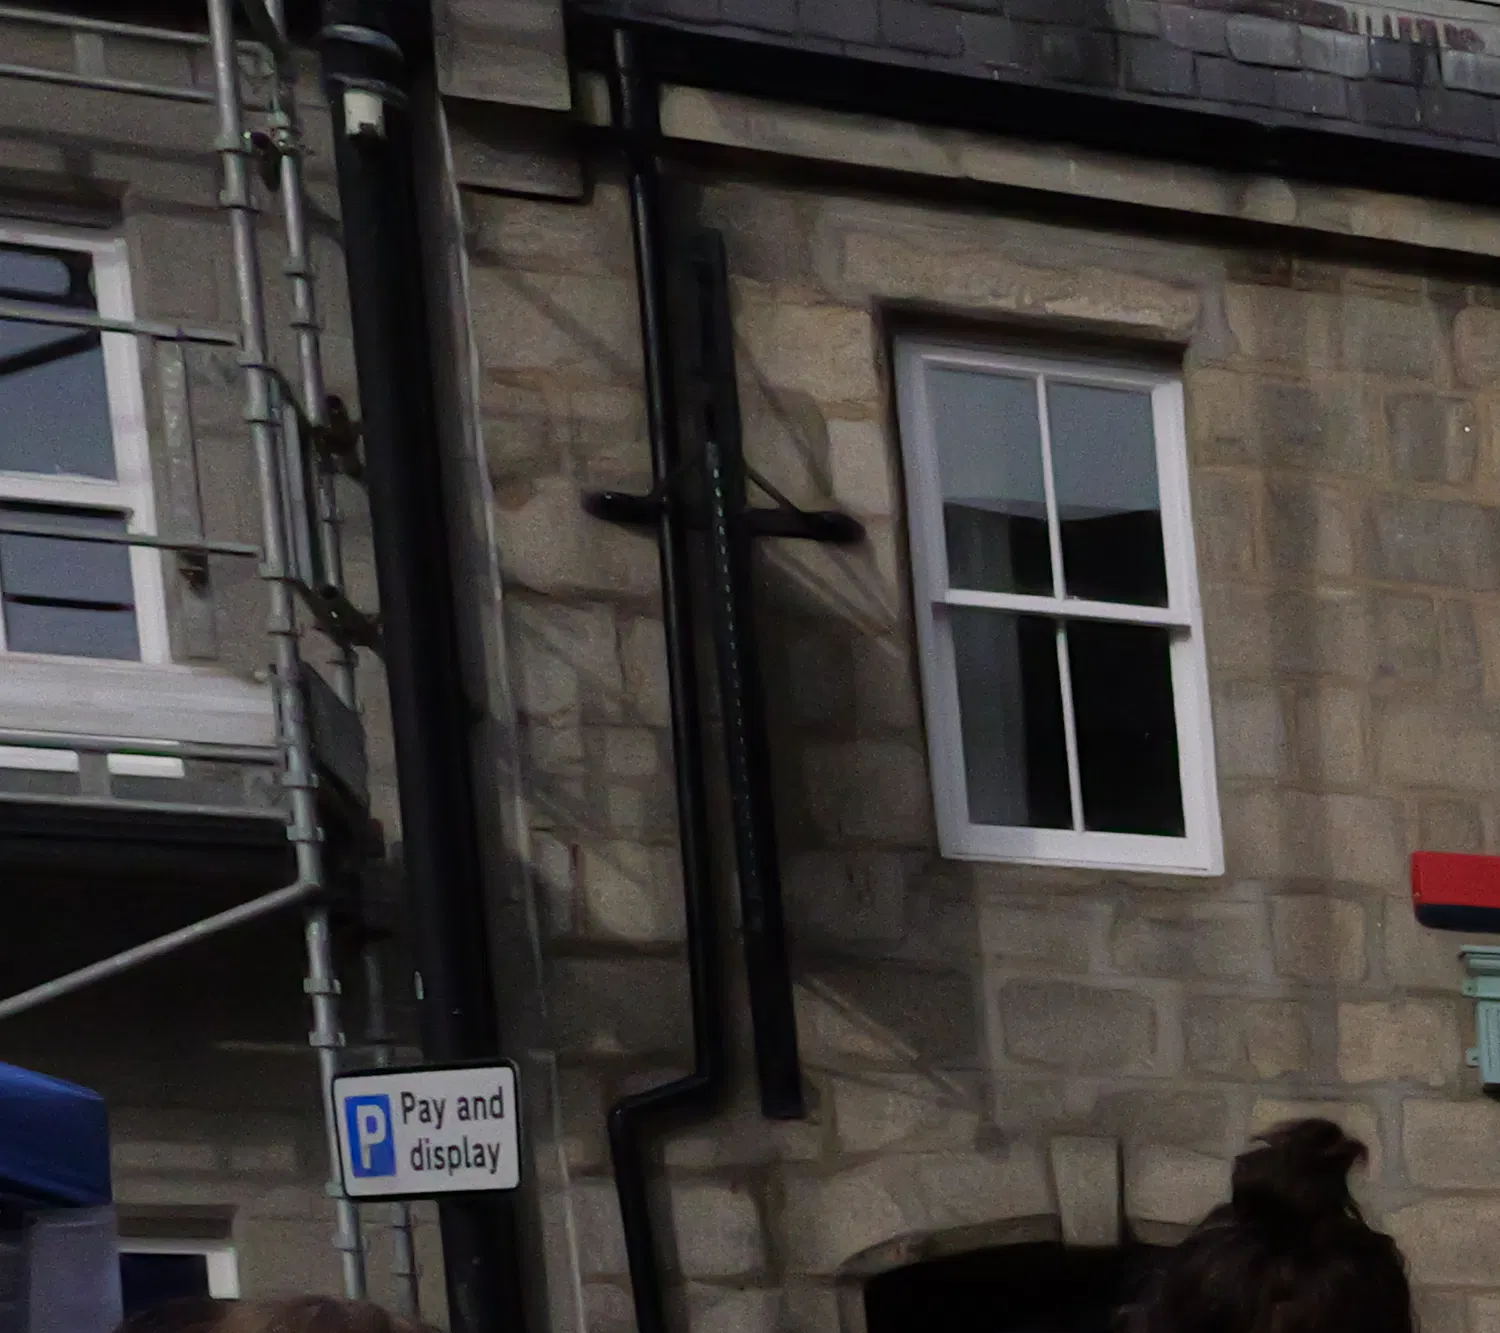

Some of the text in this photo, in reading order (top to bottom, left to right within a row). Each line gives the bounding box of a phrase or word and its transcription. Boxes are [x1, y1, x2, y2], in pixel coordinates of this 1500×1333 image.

[401, 1086, 504, 1129] Pay and
[410, 1135, 500, 1176] display
